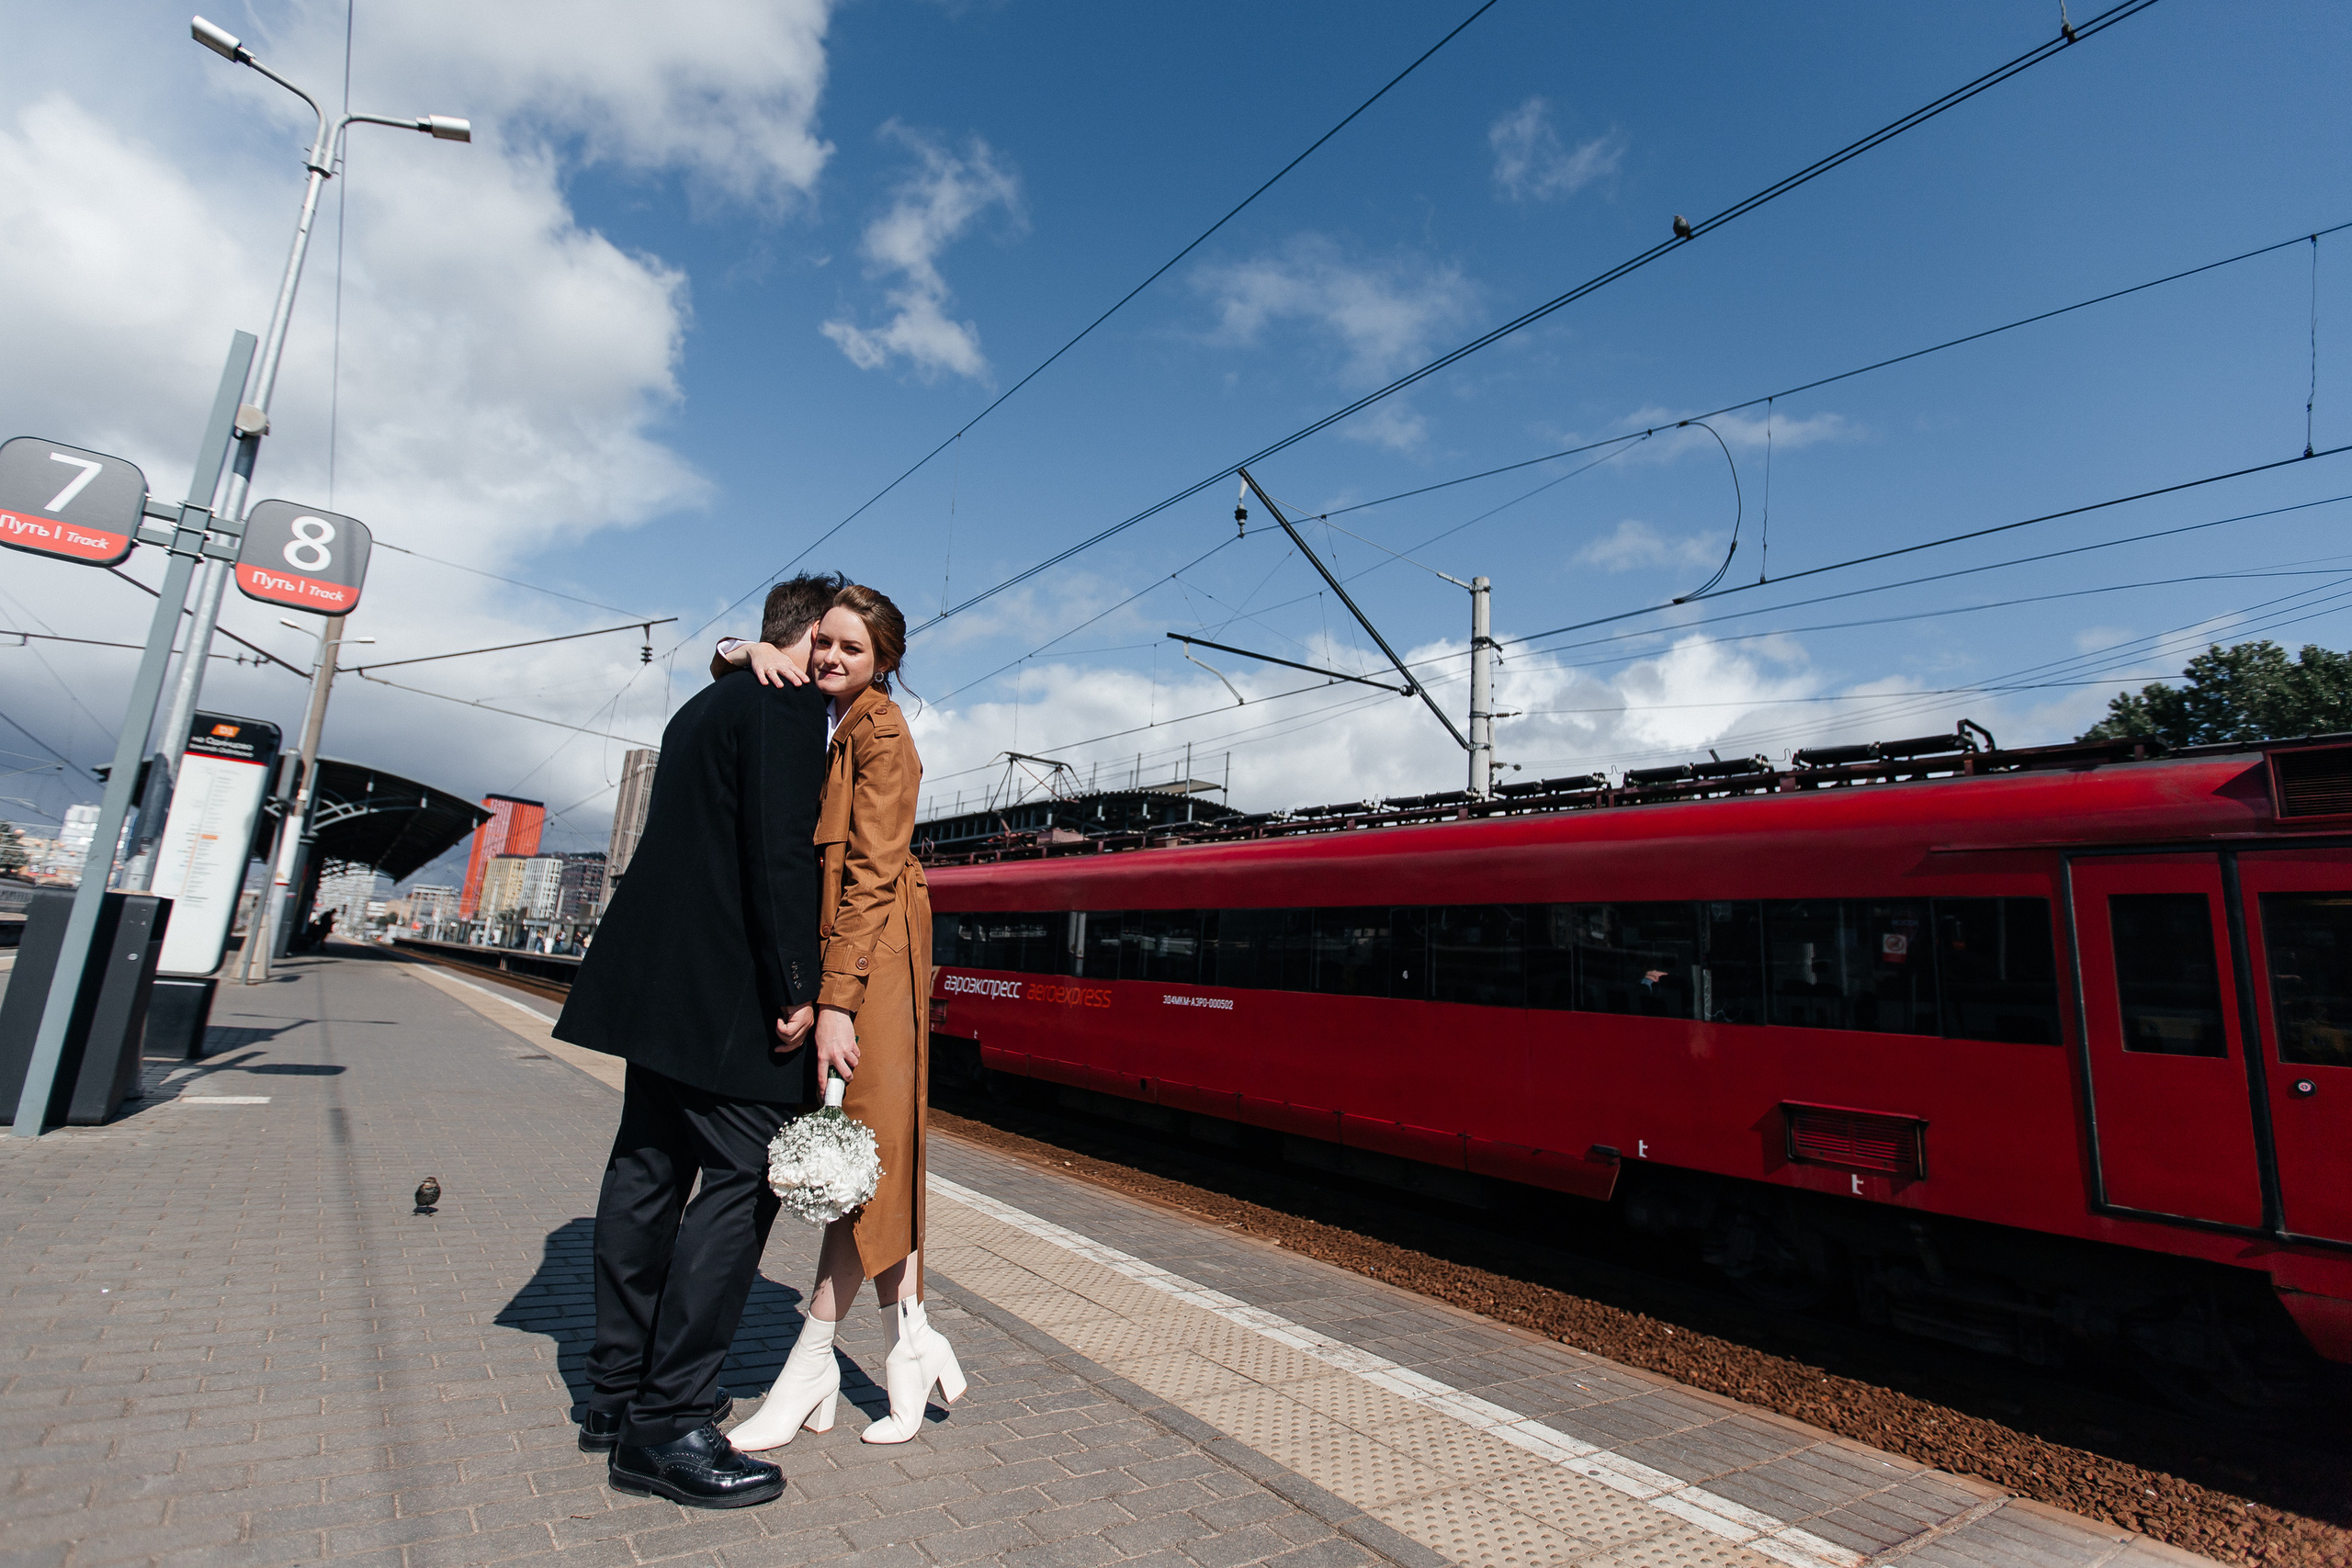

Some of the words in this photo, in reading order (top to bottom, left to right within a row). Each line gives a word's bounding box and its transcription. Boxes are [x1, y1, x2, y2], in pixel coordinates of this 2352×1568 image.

[44, 452, 103, 513] 7
[0, 513, 51, 537] Путь
[66, 531, 110, 550] Track
[283, 515, 336, 571] 8
[252, 570, 296, 591] Путь
[309, 585, 345, 603] Track
[944, 975, 1023, 1000] аэроэкспресс
[1026, 983, 1114, 1009] aeroexpress
